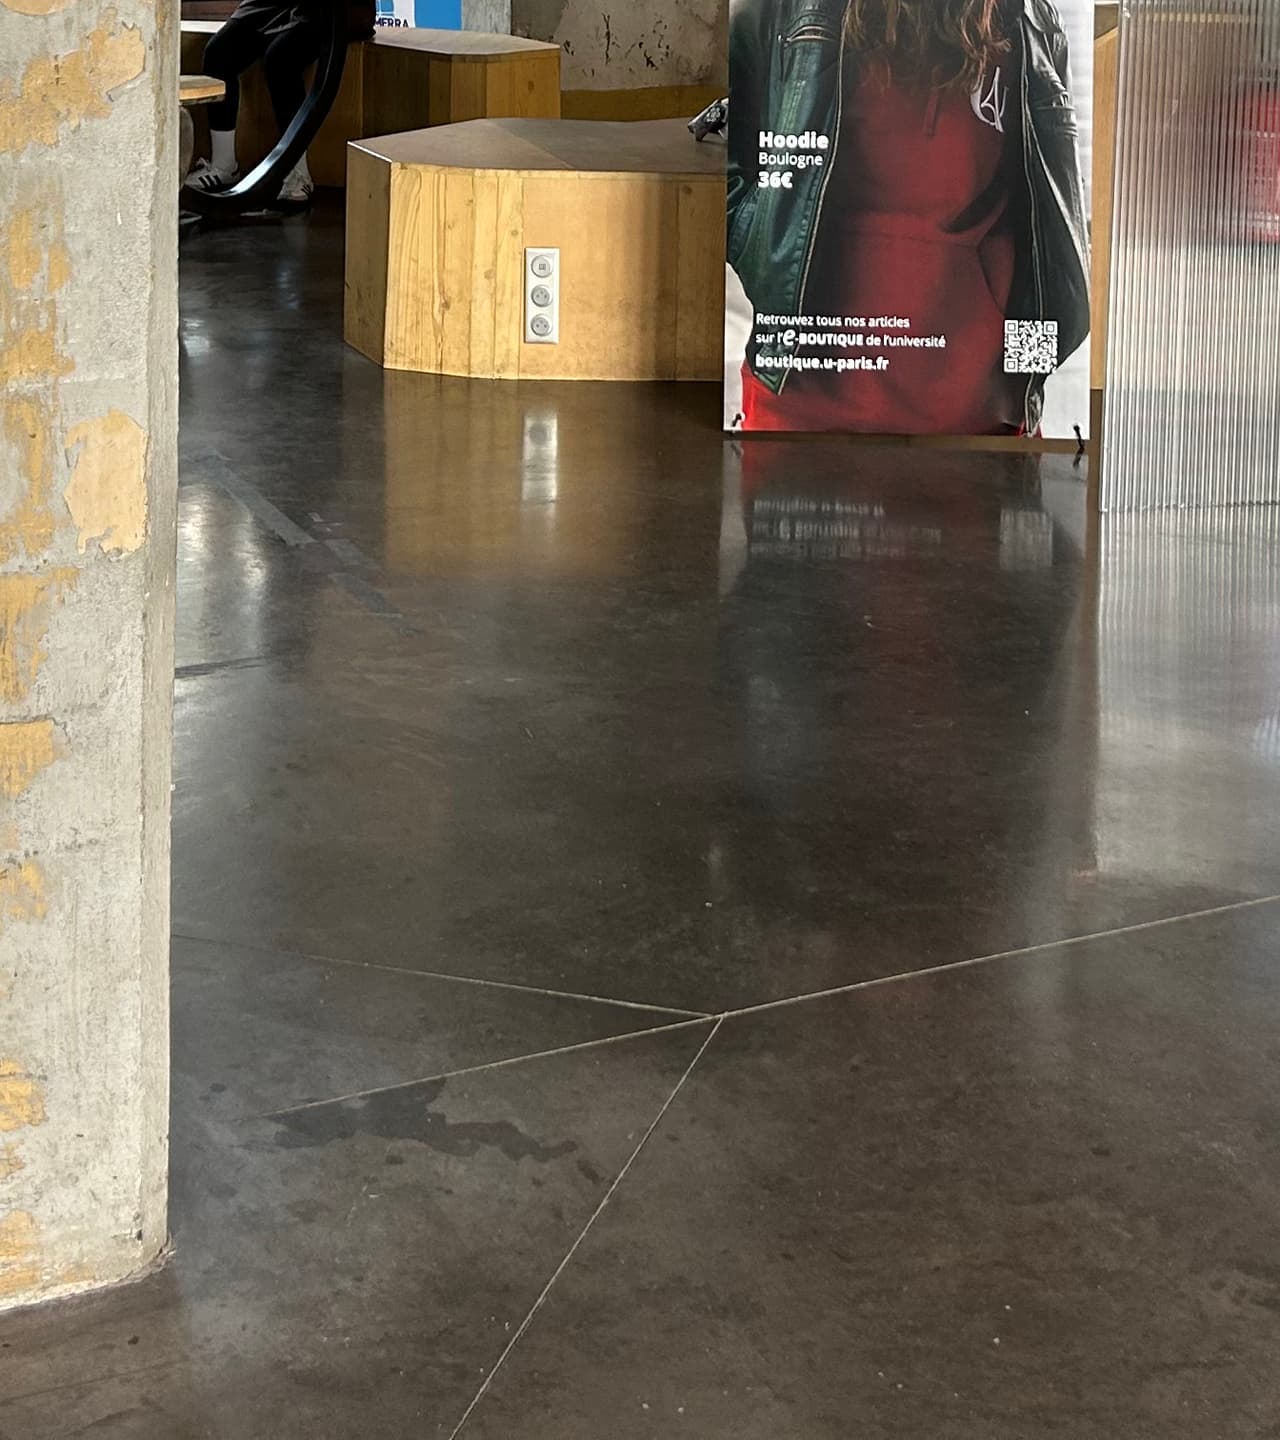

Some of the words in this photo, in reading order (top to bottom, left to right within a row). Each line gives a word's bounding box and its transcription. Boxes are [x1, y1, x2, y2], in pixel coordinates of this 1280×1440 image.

[758, 130, 830, 150] Hoodie
[758, 151, 824, 168] Boulogne
[758, 171, 794, 190] 36€
[755, 313, 815, 328] Retrouvez
[816, 315, 842, 327] tous
[844, 317, 866, 328] nos
[867, 315, 910, 328] articles
[755, 334, 776, 344] sur
[865, 334, 881, 347] de
[755, 353, 890, 373] boutique.u-paris.fr
